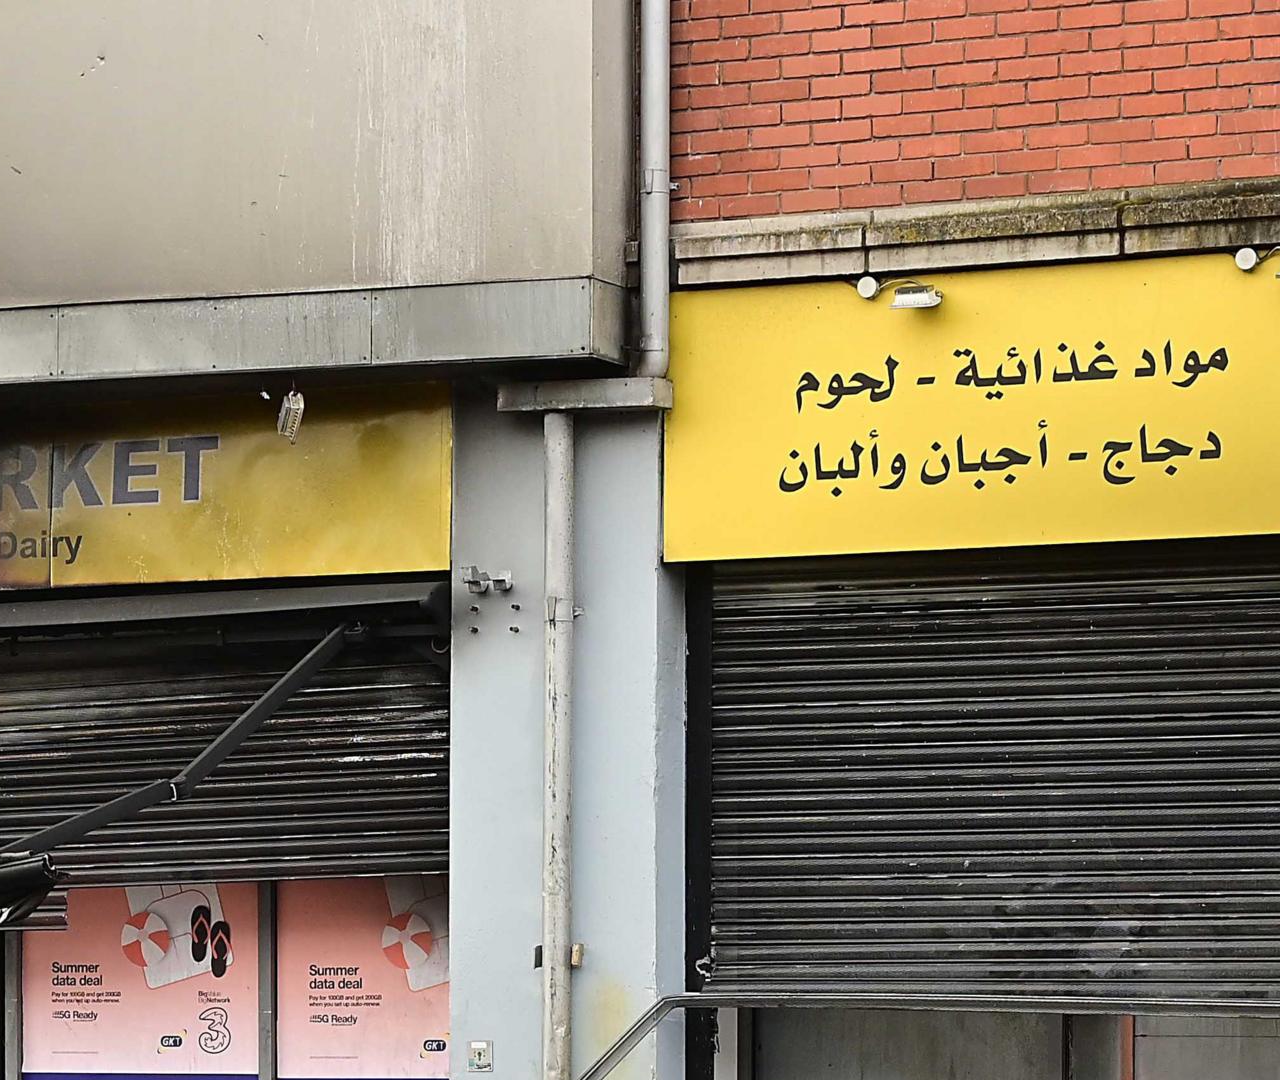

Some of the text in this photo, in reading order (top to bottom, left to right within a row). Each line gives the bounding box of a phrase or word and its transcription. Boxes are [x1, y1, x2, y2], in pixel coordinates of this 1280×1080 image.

[954, 340, 1119, 400] غذائية
[1133, 340, 1229, 388] مواد
[797, 355, 900, 413] لحوم
[778, 430, 907, 497] وألبان
[919, 420, 1049, 489] أجبان
[1101, 424, 1222, 485] دجاج
[51, 962, 100, 974] Summer
[51, 975, 103, 987] data deal
[308, 964, 360, 976] Summer
[309, 978, 363, 990] data deal
[60, 1010, 98, 1021] 5G Ready
[317, 1014, 358, 1024] 5G Ready
